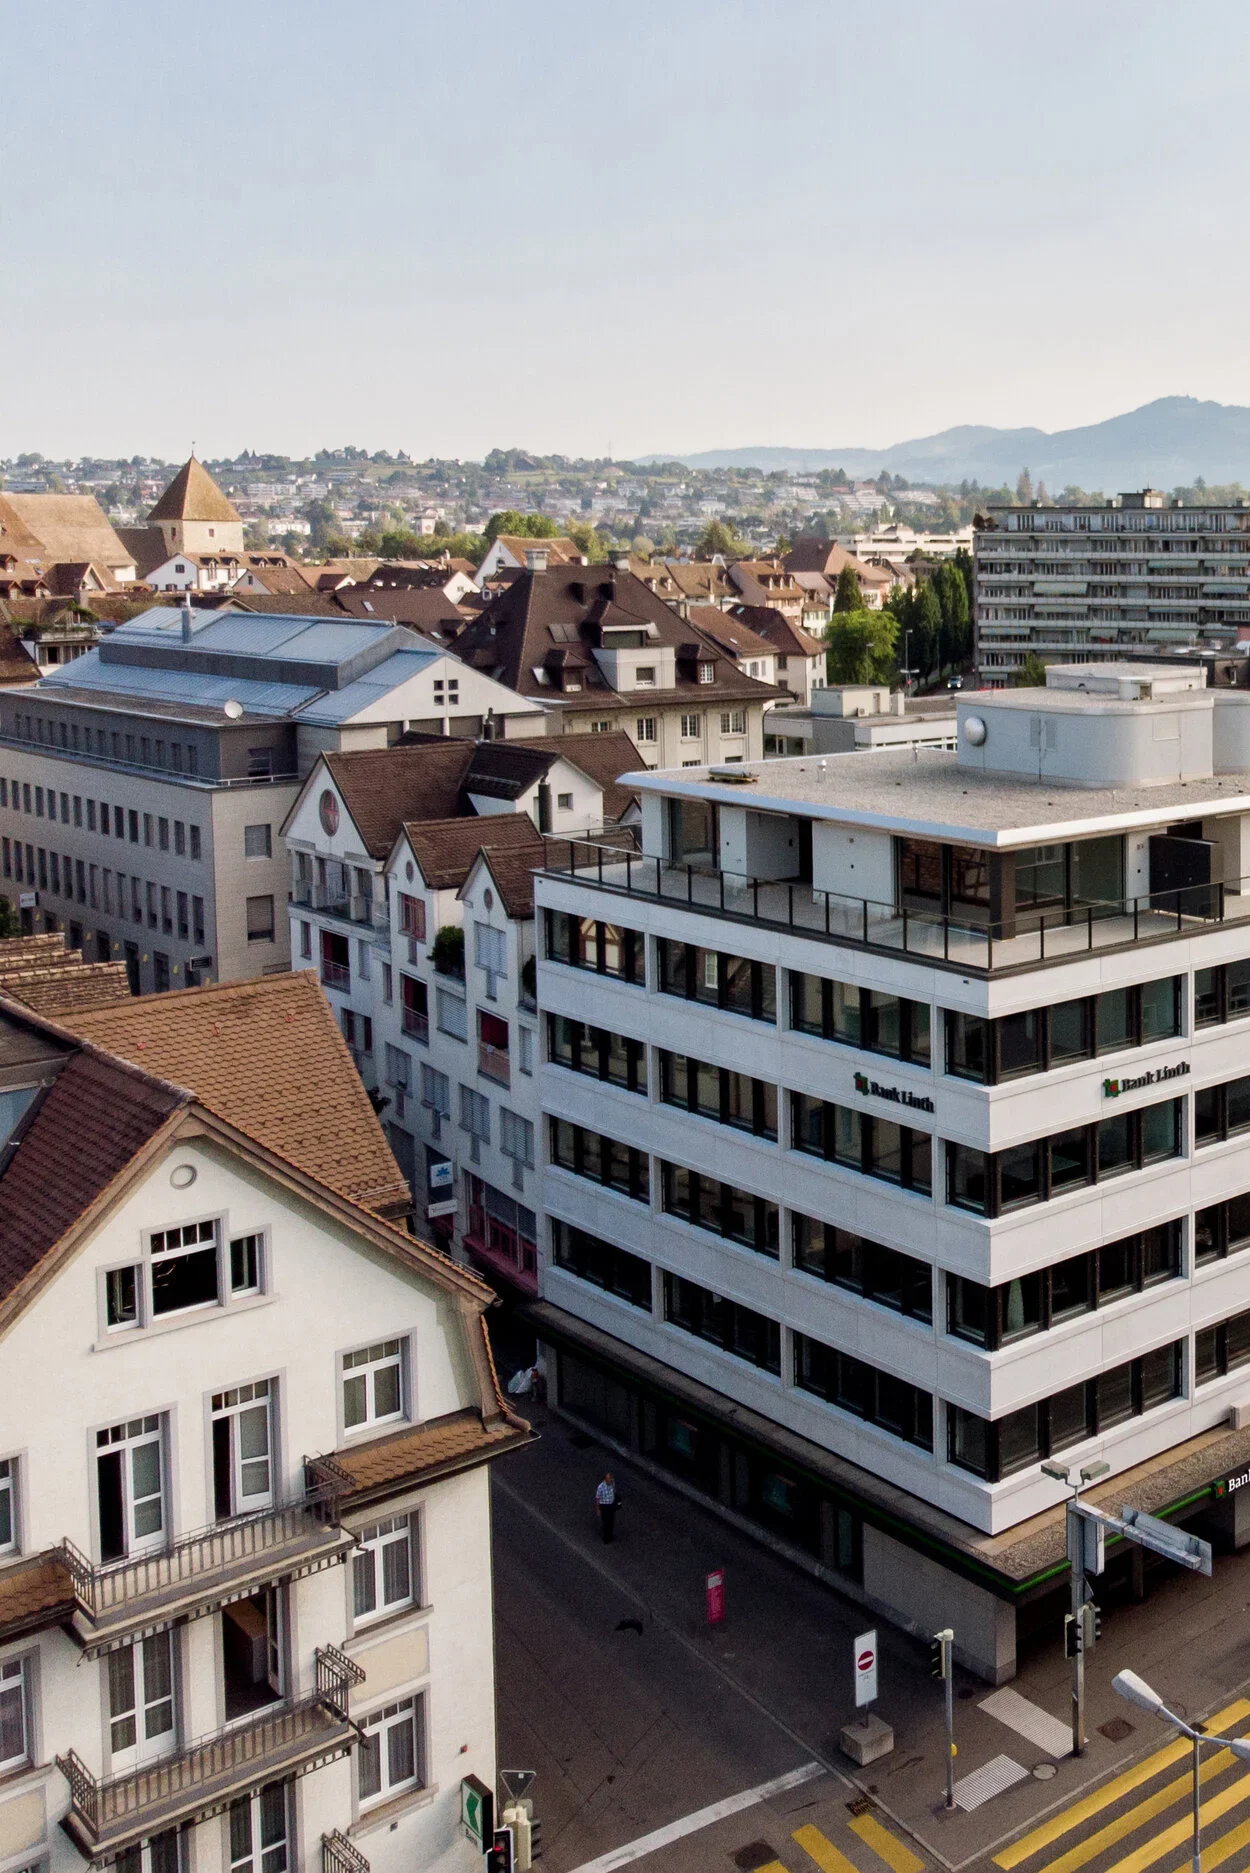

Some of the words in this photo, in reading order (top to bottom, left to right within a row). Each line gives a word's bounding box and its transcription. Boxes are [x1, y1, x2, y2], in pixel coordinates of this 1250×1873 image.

[1121, 1071, 1155, 1092] Bank
[1156, 1061, 1191, 1082] Linth
[870, 1081, 901, 1103] Bank
[901, 1091, 935, 1113] Linth
